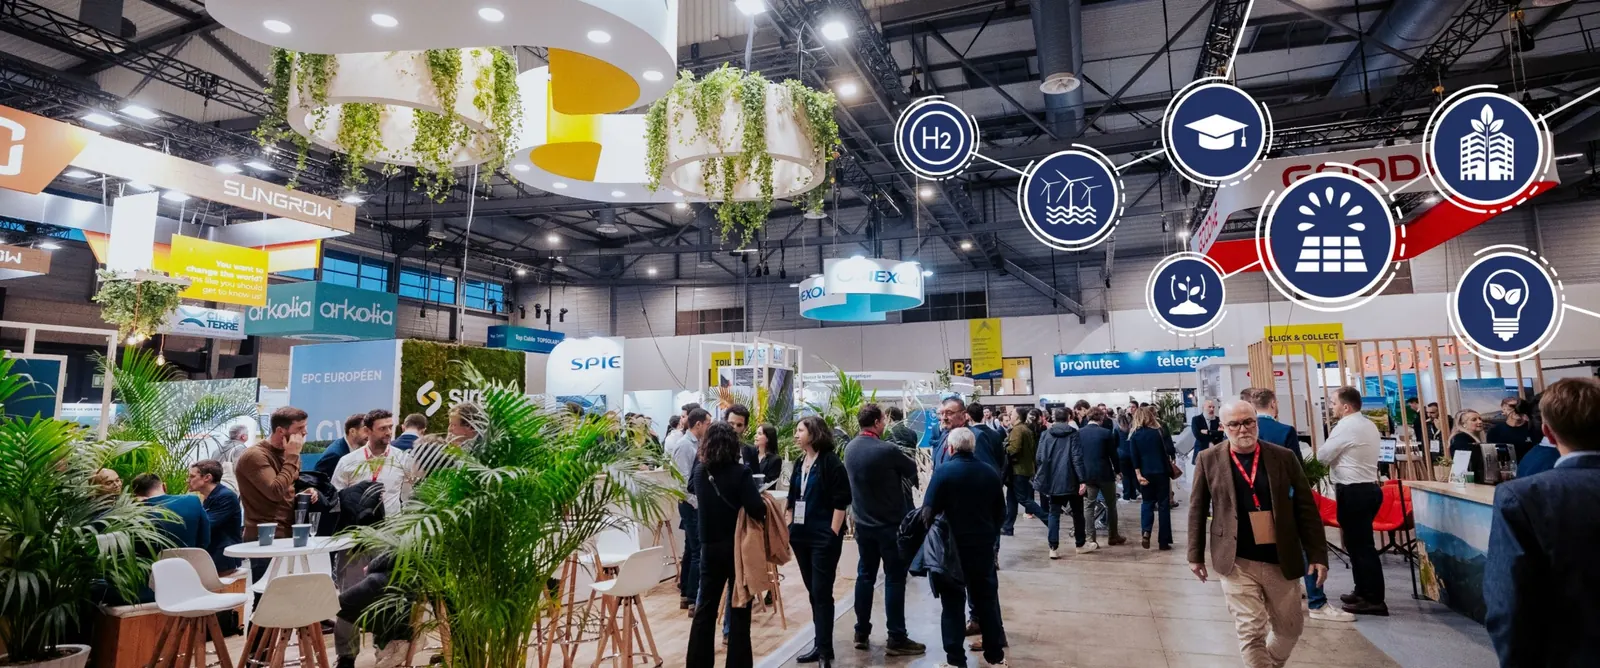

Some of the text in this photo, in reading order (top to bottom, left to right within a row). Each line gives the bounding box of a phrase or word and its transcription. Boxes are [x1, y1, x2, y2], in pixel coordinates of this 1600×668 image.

[1282, 153, 1435, 188] GOD
[223, 180, 332, 220] SUNGROW
[185, 265, 264, 283] change the world?
[216, 260, 232, 269] You
[233, 264, 254, 273] want
[175, 272, 263, 291] Sms like you should
[202, 287, 216, 295] get
[228, 289, 249, 298] know
[801, 286, 826, 302] EXO
[248, 296, 312, 321] arkolia
[320, 299, 393, 326] arkolia
[206, 319, 239, 331] TERRE
[515, 334, 523, 342] Top
[1268, 334, 1292, 342] CLICK
[1302, 333, 1340, 341] COLLECT
[571, 355, 621, 371] SPIE
[715, 358, 745, 367] TOILTT
[1060, 354, 1218, 373] pronutec telerg
[301, 368, 382, 384] EPC EUROPÉEN
